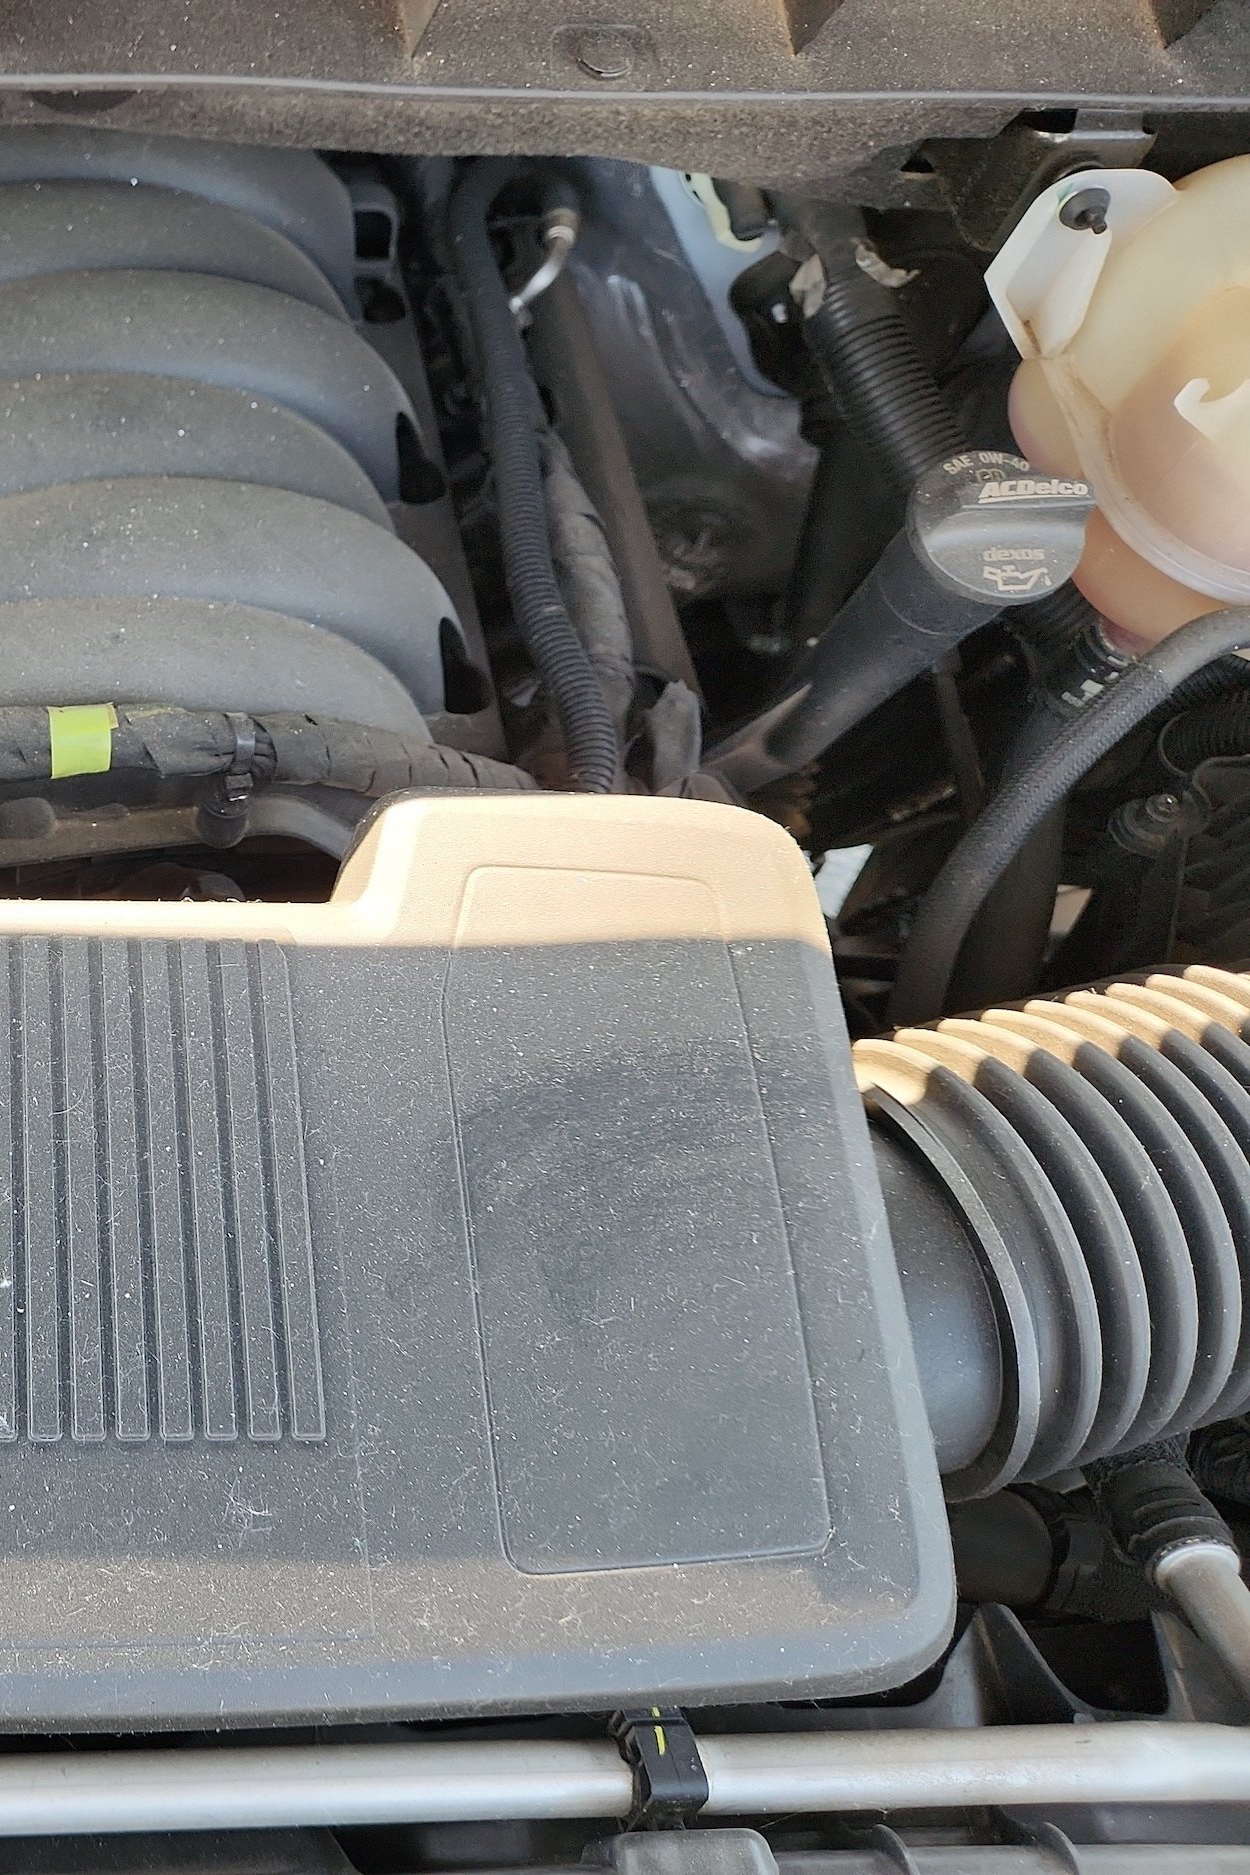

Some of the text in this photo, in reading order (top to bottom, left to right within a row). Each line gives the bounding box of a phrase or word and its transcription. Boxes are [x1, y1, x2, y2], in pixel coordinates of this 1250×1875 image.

[943, 452, 1030, 475] SAE 0W-40
[978, 479, 1089, 500] ACDelco
[982, 547, 1045, 562] dexos
